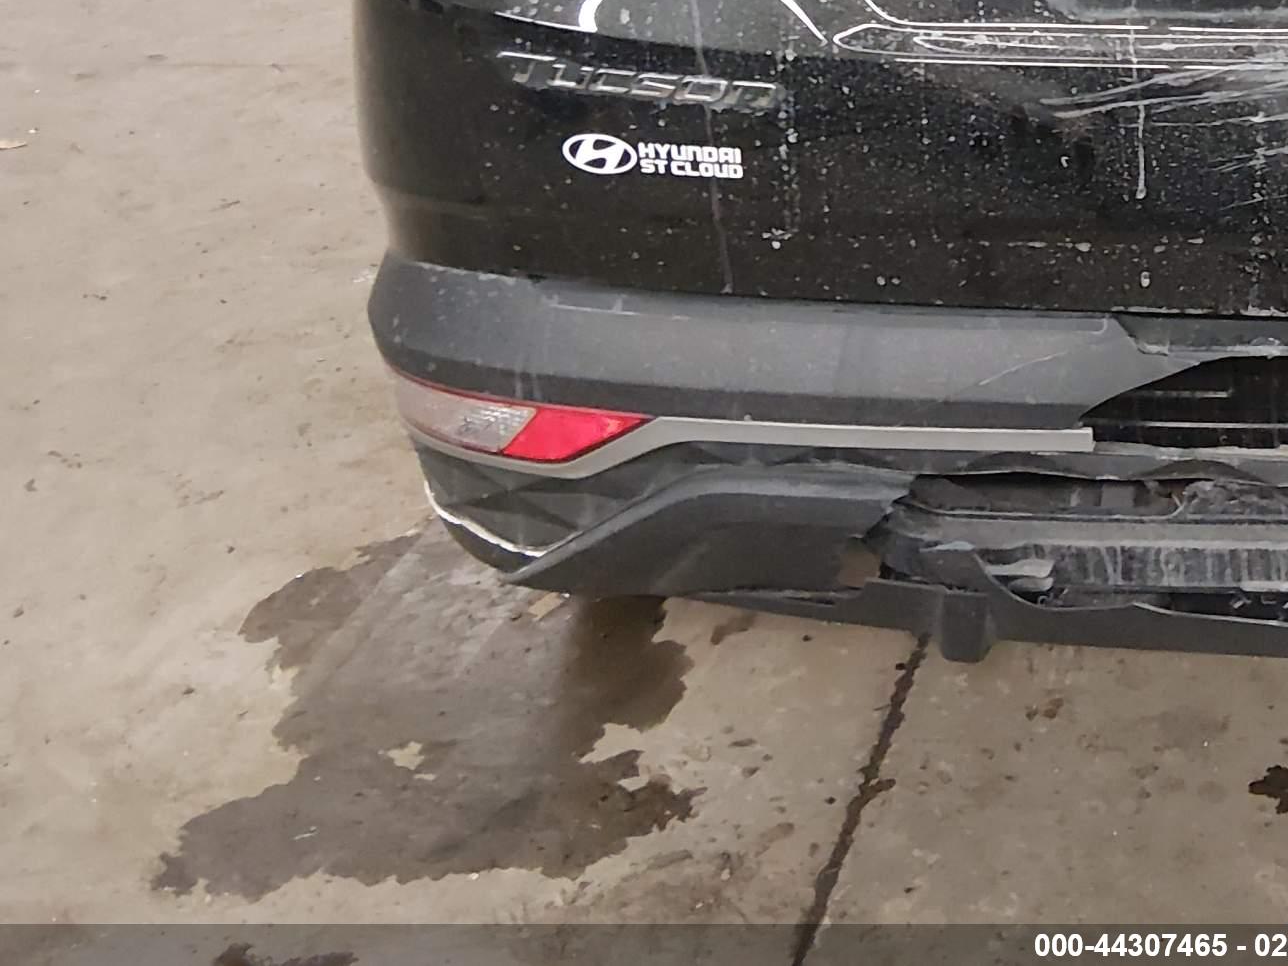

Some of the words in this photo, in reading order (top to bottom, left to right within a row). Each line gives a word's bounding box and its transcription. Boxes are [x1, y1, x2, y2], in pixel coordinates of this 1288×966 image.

[637, 141, 742, 164] HYUNDAI
[639, 157, 668, 175] ST
[670, 160, 744, 179] CLOUD
